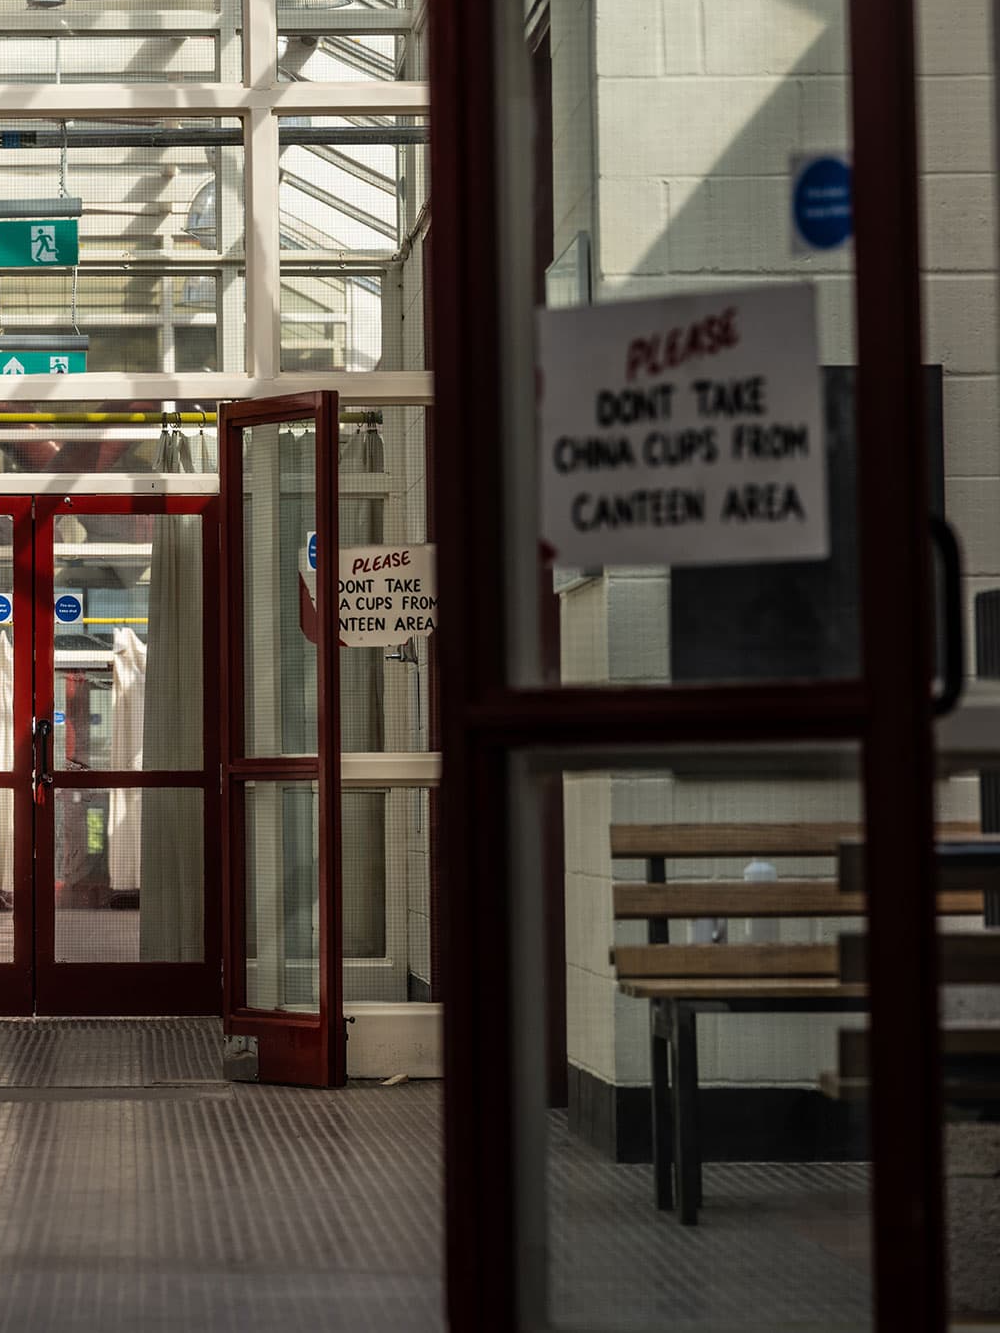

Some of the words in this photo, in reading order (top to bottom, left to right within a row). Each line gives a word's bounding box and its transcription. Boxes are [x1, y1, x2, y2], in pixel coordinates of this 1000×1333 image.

[627, 306, 741, 381] PLEASE
[595, 384, 674, 427] DONT
[693, 375, 766, 422] TAKE
[553, 435, 635, 474] CHINA
[642, 426, 719, 467] CUPS
[732, 424, 809, 461] FROM
[571, 489, 706, 533] CANTEEN
[721, 483, 806, 524] AREA
[352, 550, 412, 575] PLEASE
[356, 596, 393, 611] CUPS
[402, 595, 440, 610] FROM
[384, 577, 421, 593] TAKE
[338, 616, 386, 632] NTEEN
[394, 616, 435, 631] AREA
